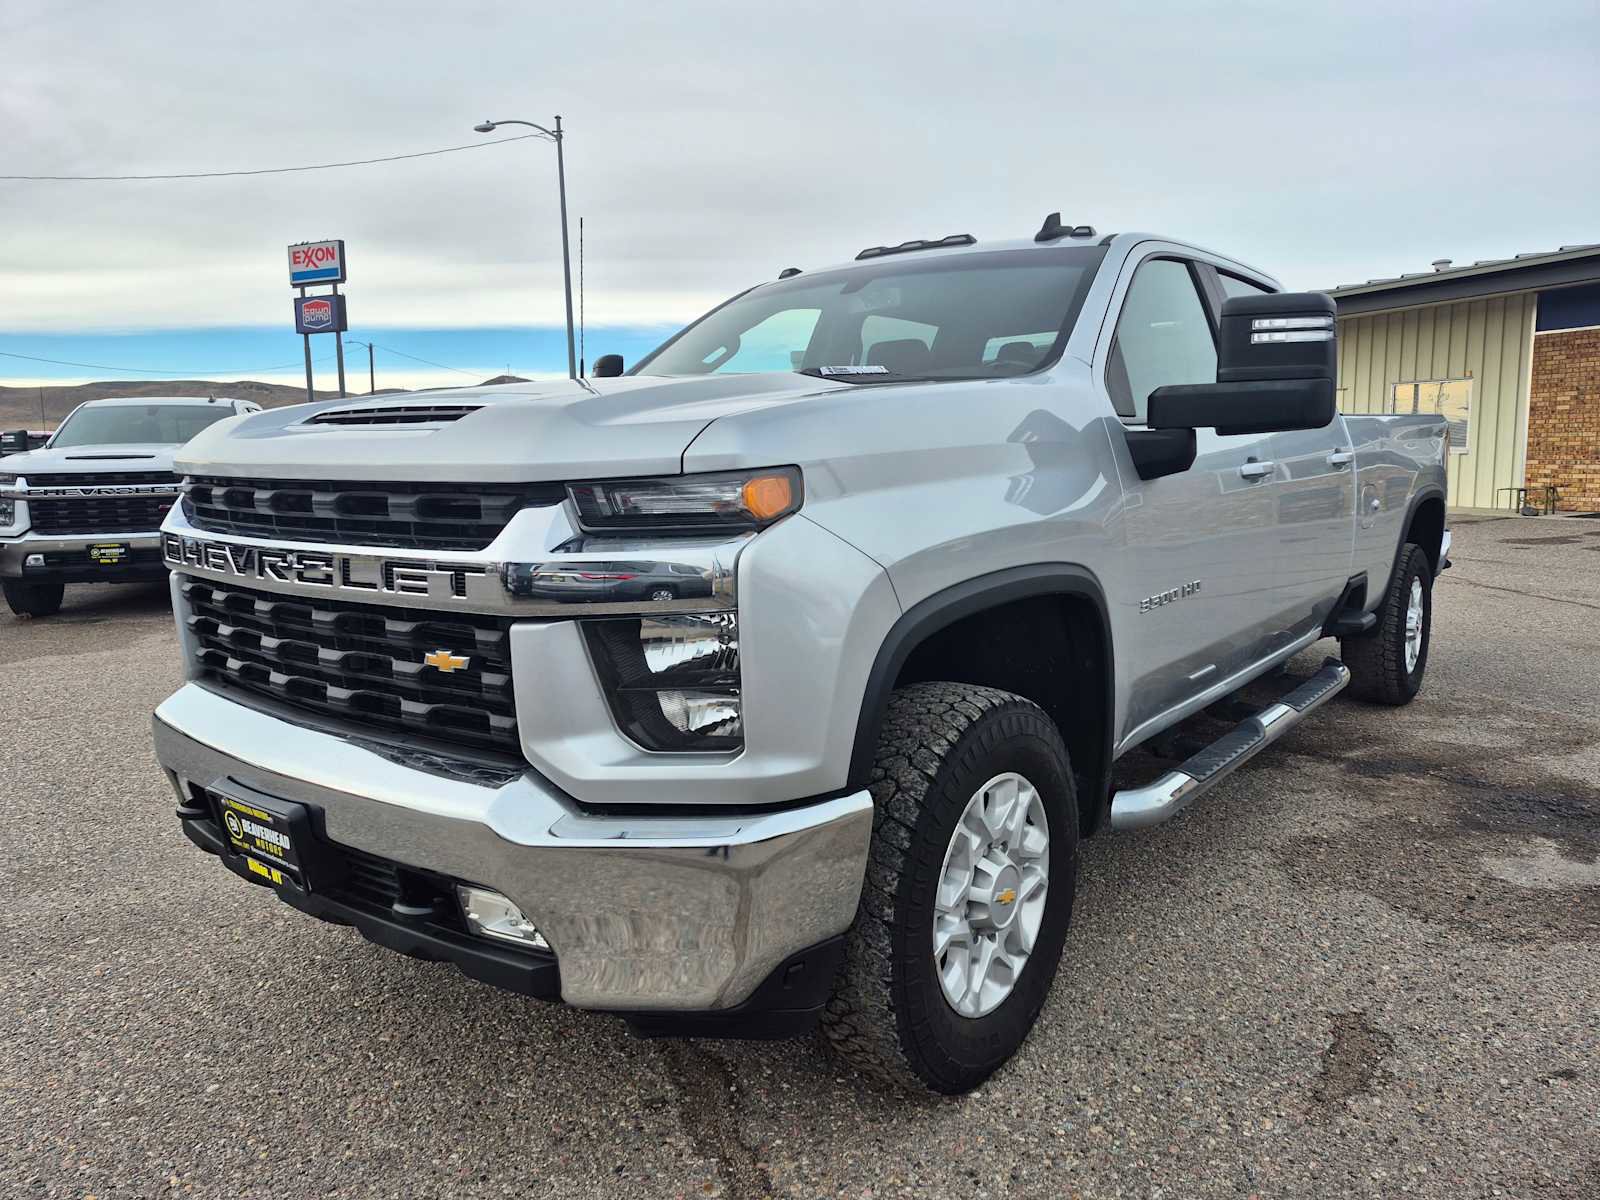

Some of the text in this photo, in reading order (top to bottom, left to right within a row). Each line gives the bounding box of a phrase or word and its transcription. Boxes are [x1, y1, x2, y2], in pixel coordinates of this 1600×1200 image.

[292, 246, 335, 268] EXXON
[27, 486, 182, 497] CHEVROLET
[160, 531, 487, 600] CHEVROLET
[1181, 579, 1201, 598] HD
[241, 817, 291, 850] BEAVERHEAD
[255, 838, 283, 857] MOTORS
